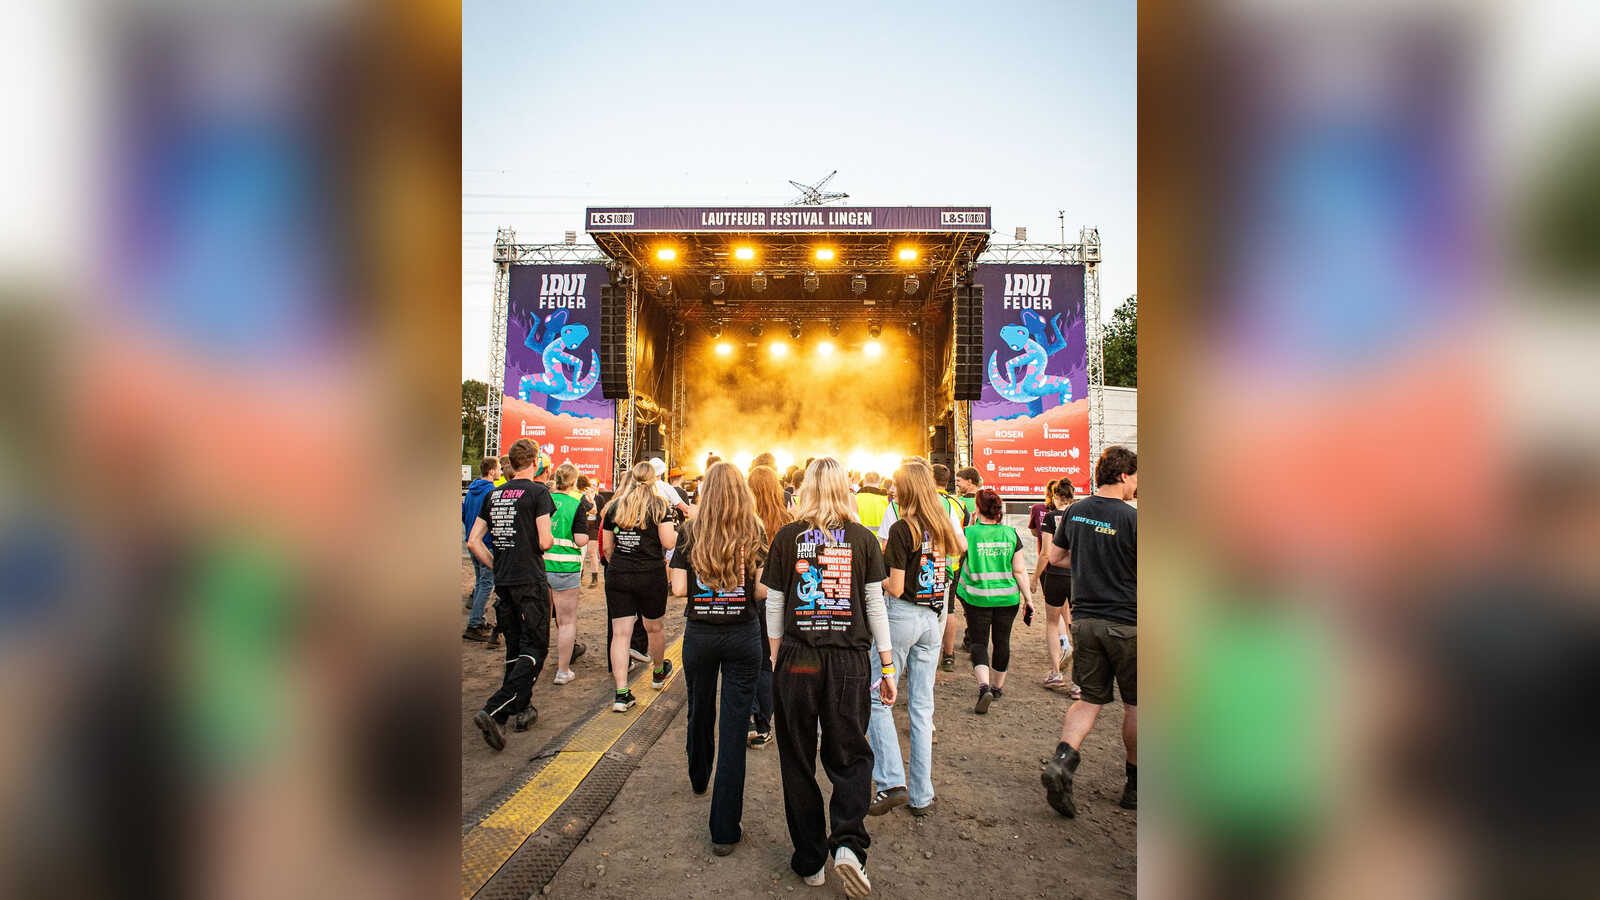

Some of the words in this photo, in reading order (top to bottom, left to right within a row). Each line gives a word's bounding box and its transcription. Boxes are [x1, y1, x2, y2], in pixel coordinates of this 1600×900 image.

[592, 214, 613, 224] L&S
[701, 212, 766, 226] LAUTFEUER
[770, 212, 824, 226] FESTIVAL
[829, 212, 873, 226] LINGEN
[943, 213, 964, 223] L&S
[540, 273, 587, 296] LAUT
[1003, 273, 1052, 297] LAUT
[539, 296, 586, 309] FEUER
[1003, 296, 1052, 310] FEUER
[572, 428, 600, 436] ROSEN
[994, 430, 1025, 439] ROSEN
[1033, 448, 1068, 457] Emsland
[1034, 465, 1080, 474] westenergie
[502, 489, 526, 499] CREW
[804, 528, 846, 546] CRW
[797, 542, 817, 553] LAUT
